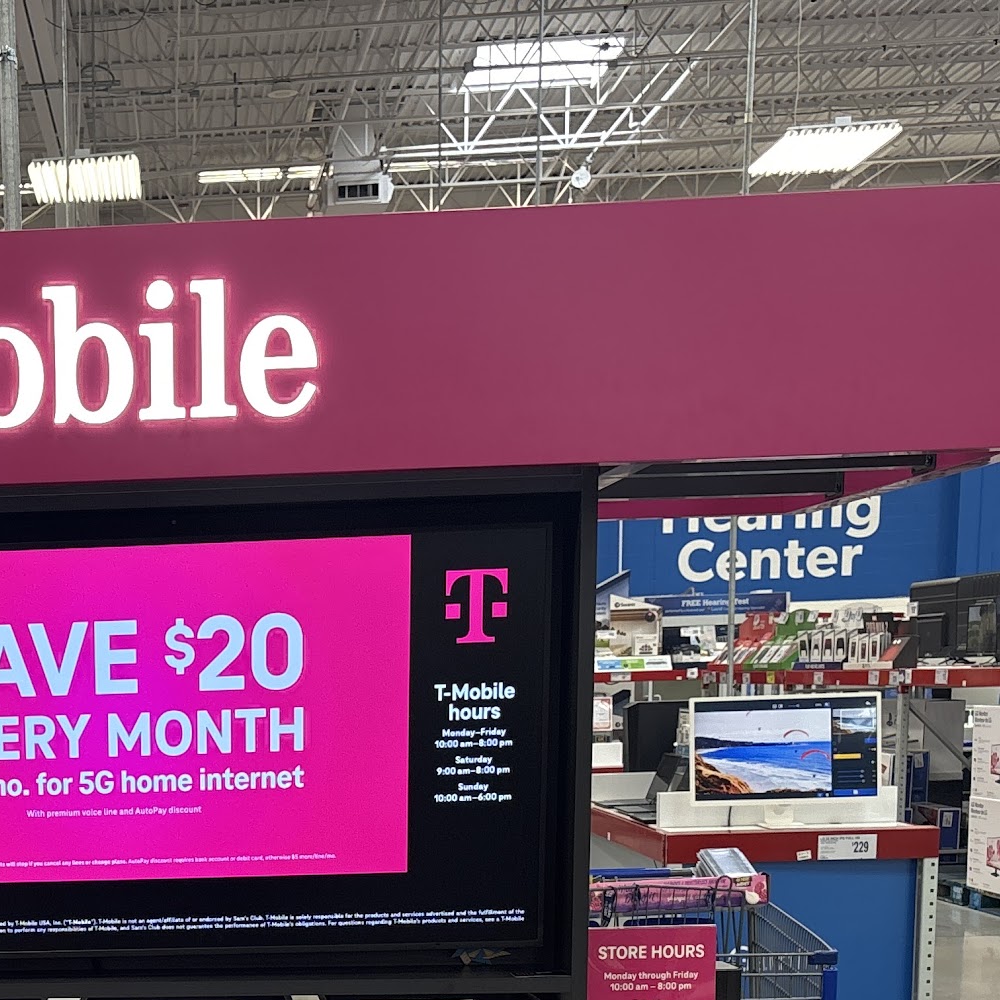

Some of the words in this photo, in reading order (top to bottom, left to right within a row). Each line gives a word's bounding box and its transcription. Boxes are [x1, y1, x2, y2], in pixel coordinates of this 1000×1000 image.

[678, 538, 864, 582] Center
[164, 611, 304, 692] $20
[434, 681, 515, 701] T-Mobile
[448, 703, 500, 721] hours
[106, 706, 304, 758] MONTH
[441, 727, 506, 738] Monday–Friday
[434, 739, 458, 748] 10:00
[459, 738, 498, 748] am–8:00
[498, 739, 513, 748] pm
[454, 755, 492, 765] Saturday
[436, 766, 456, 775] 9:00
[456, 766, 495, 775] am–8:00
[496, 766, 510, 775] pm
[35, 771, 73, 796] for
[78, 769, 114, 795] 5G
[120, 769, 193, 794] home
[198, 764, 305, 791] internet
[457, 782, 489, 792] Sunday
[433, 793, 458, 802] 10:00
[458, 792, 497, 801] am–6:00
[498, 794, 512, 802] pm
[46, 809, 80, 818] premium
[118, 807, 134, 815] and
[134, 806, 167, 815] AutoPay
[168, 805, 202, 814] discount
[852, 841, 869, 853] $229
[598, 945, 647, 959] STORE
[651, 943, 704, 958] HOURS
[603, 972, 637, 981] Monday
[638, 970, 671, 980] through
[672, 970, 698, 980] Friday
[610, 982, 634, 991] 10:00
[657, 981, 676, 990] 8:00
[678, 982, 692, 991] pm
